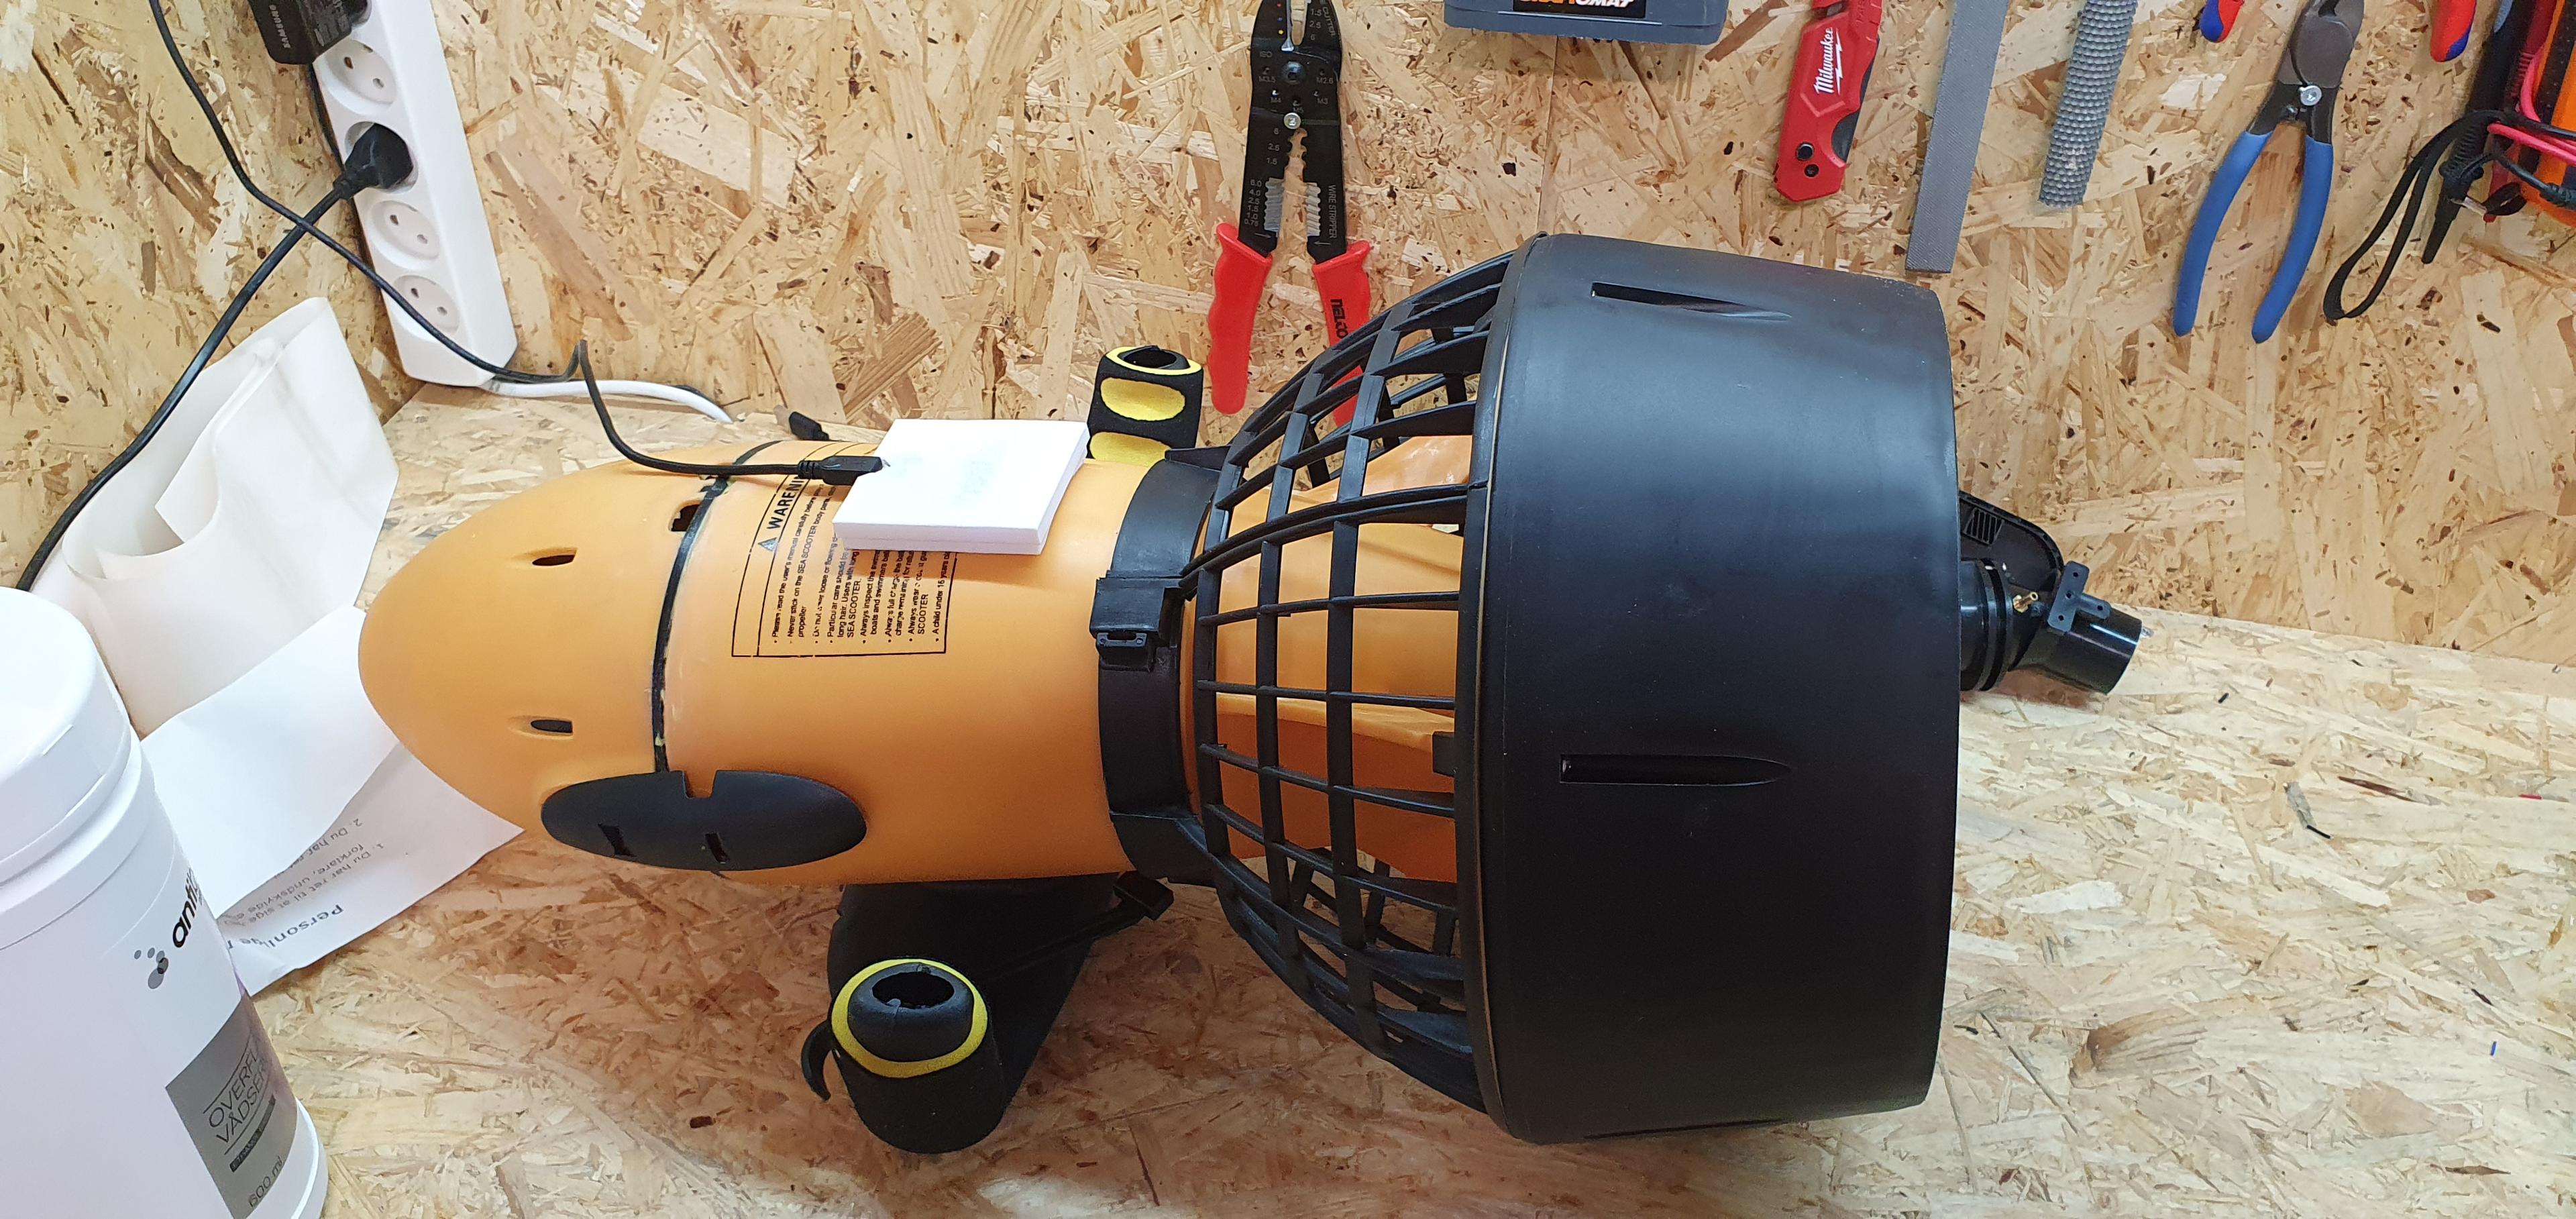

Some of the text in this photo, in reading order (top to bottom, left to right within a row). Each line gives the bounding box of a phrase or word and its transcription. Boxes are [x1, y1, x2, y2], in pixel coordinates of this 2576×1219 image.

[269, 5, 291, 48] SAMSUNG
[1813, 27, 1834, 94] Milwaukee
[1267, 157, 1278, 165] 1.5
[1250, 179, 1262, 187] 6.0
[1248, 205, 1259, 213] 1.5
[1328, 184, 1337, 239] WIRE STRIPPER
[812, 511, 824, 524] body
[802, 526, 817, 558] SCOOTER
[797, 560, 806, 574] SEA
[836, 562, 846, 583] should
[795, 576, 803, 586] the
[818, 575, 828, 593] loose
[794, 588, 800, 596] on
[841, 582, 851, 602] Users
[848, 578, 861, 619] SCOOTER.
[863, 583, 873, 608] inspect
[870, 615, 878, 635] boats
[875, 564, 887, 597] swimmers
[798, 606, 806, 637] propeller
[860, 611, 869, 636] Always
[908, 608, 918, 634] Always
[918, 594, 928, 635] SCOOTER
[932, 611, 941, 627] child
[787, 615, 796, 637] Never
[837, 622, 846, 637] long
[309, 818, 362, 855] 2. Du har
[354, 851, 370, 863] Du
[248, 844, 363, 912] forklare, undskylde
[332, 864, 352, 878] har
[309, 879, 327, 892] ret
[294, 892, 307, 901] til
[249, 908, 274, 923] sige
